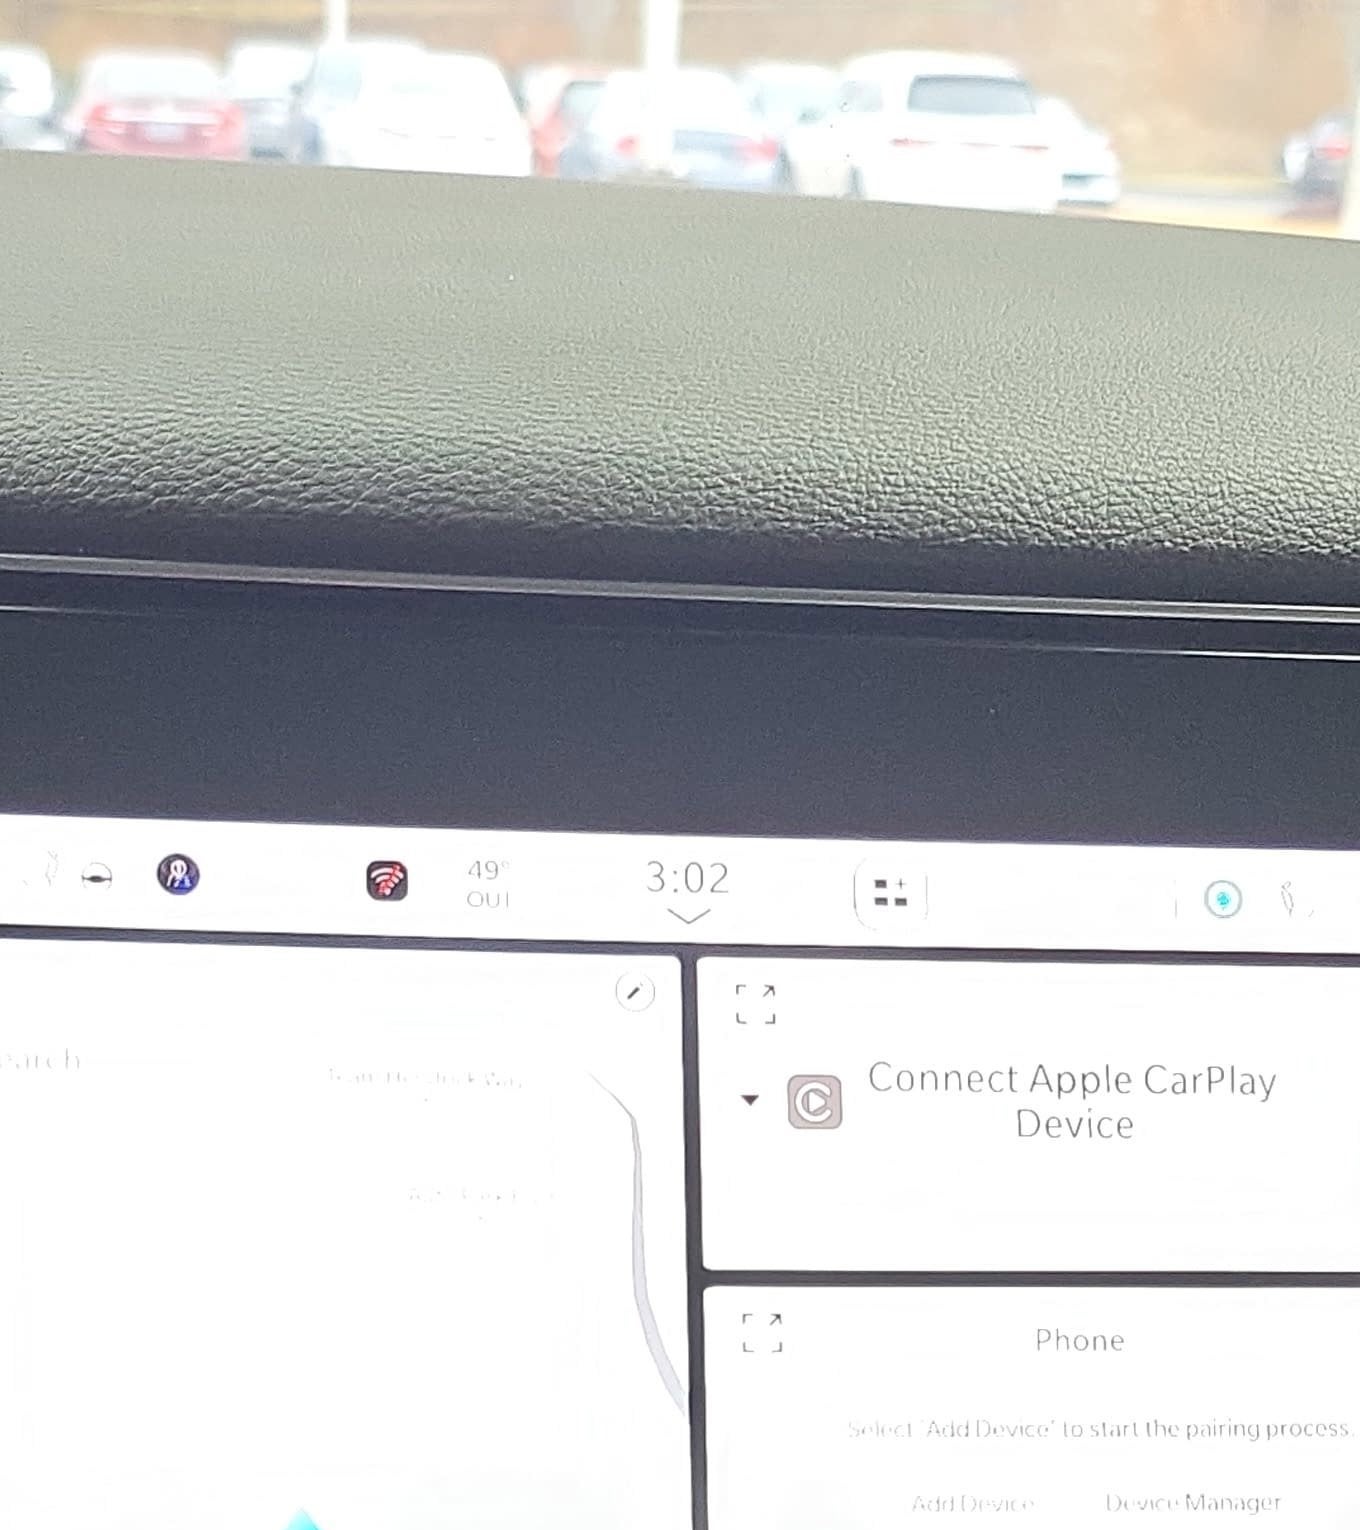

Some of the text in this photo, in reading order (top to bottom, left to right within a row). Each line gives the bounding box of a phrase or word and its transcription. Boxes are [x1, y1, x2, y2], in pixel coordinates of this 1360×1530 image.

[467, 859, 511, 882] 49°
[646, 859, 729, 895] 3:02
[867, 1060, 1278, 1103] Connect Apple CarPlay
[1015, 1108, 1135, 1140] Device
[1035, 1327, 1126, 1354] Phone
[848, 1417, 914, 1440] Select
[1062, 1419, 1084, 1440] to
[1090, 1419, 1140, 1440] start
[1145, 1418, 1181, 1440] the
[1186, 1418, 1261, 1443] pairing
[1265, 1419, 1356, 1442] process.
[912, 1493, 1037, 1514] Add Device
[1106, 1493, 1282, 1517] Device Manager
